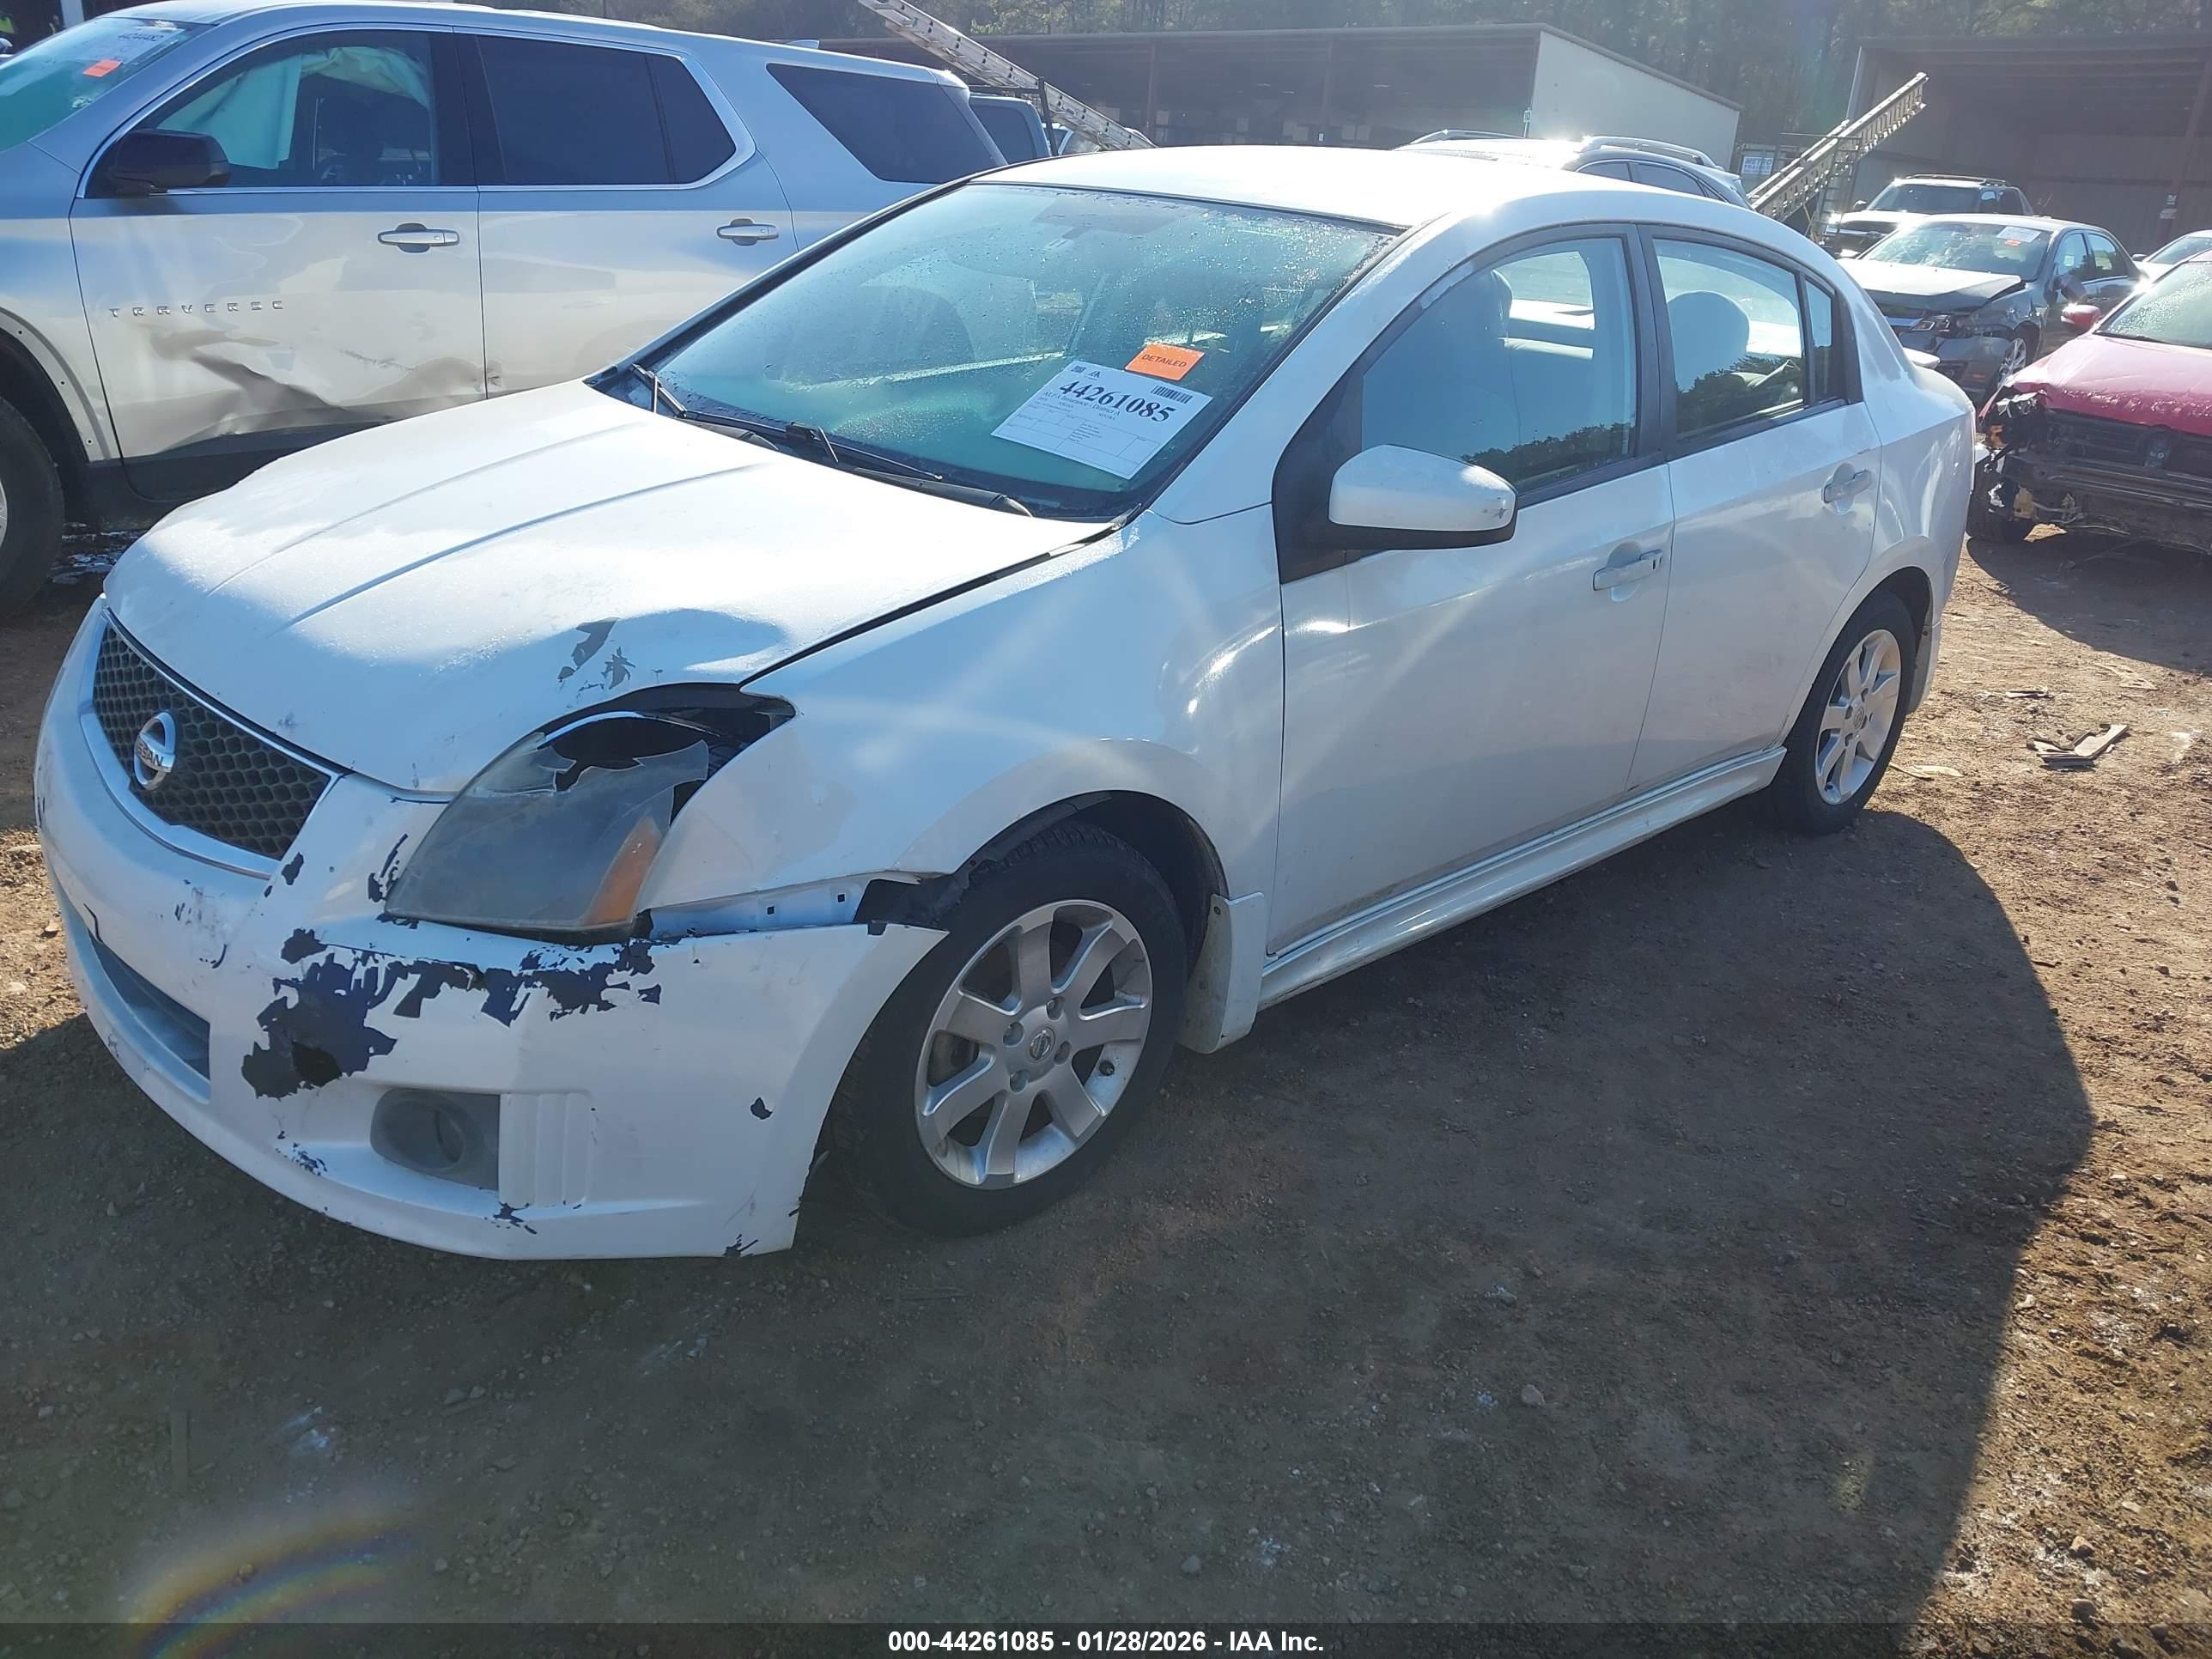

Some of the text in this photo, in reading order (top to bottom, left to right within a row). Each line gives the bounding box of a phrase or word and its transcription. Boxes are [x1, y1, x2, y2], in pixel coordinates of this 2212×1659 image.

[108, 300, 284, 318] TRAVERSE
[1141, 354, 1188, 368] DETAILED
[1059, 380, 1177, 422] 44261085
